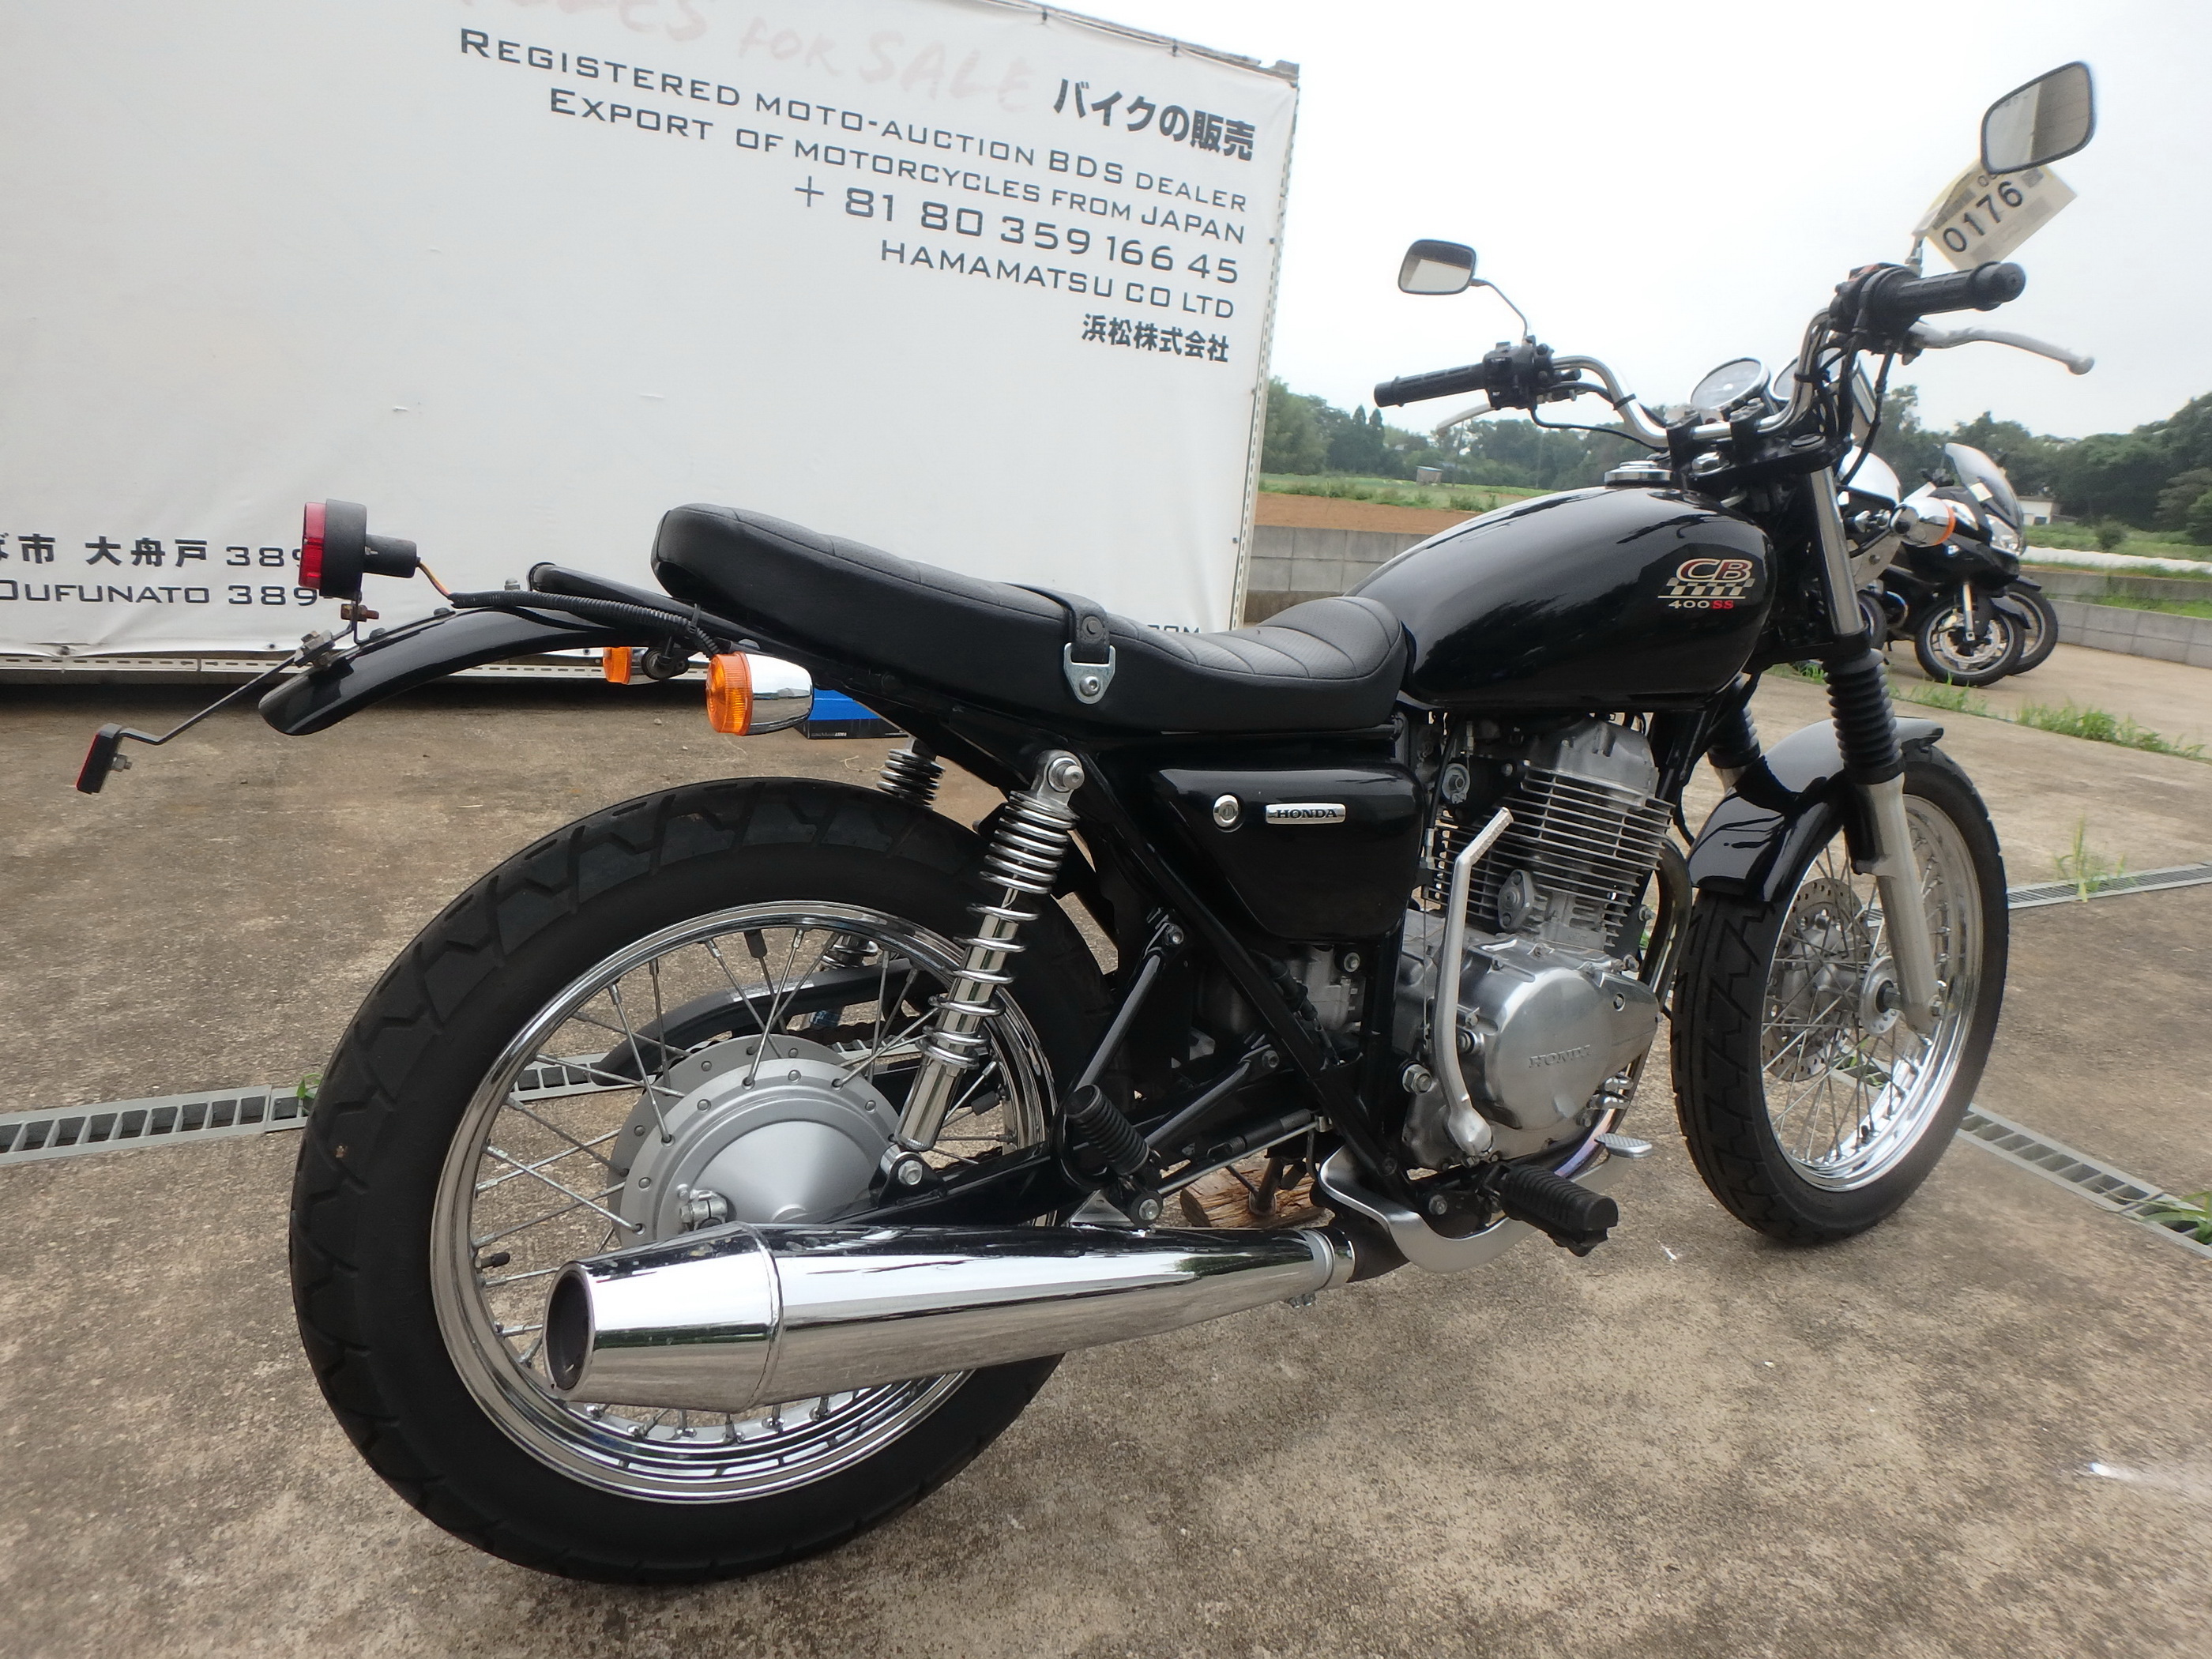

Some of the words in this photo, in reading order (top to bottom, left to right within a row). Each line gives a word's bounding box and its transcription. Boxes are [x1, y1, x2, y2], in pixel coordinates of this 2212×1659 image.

[461, 28, 740, 107] REGISTERED
[757, 92, 1034, 166] MOTO-AUCTION
[1048, 150, 1123, 185] BDS
[1136, 172, 1246, 213] DEALER
[1053, 78, 1255, 161] バイクの販売
[551, 88, 713, 140] EXPORT
[736, 129, 784, 152] OF
[795, 140, 1040, 203] MOTORCYCLES
[1052, 190, 1130, 221] FROM
[1141, 206, 1244, 244] JAPAN
[845, 188, 893, 222] 81
[921, 201, 984, 237] 80
[1000, 216, 1090, 254] 359
[1106, 236, 1173, 271] 166
[1188, 254, 1238, 284] 45
[1943, 181, 2023, 253] 0176
[882, 240, 1113, 298] HAMAMATSU
[1125, 283, 1171, 308] CO
[1183, 292, 1234, 318] LTD
[1081, 314, 1229, 363] 浜松株式会社
[85, 536, 208, 568] 大舟戸
[1676, 558, 1753, 583] CB
[1275, 809, 1337, 818] HONDA
